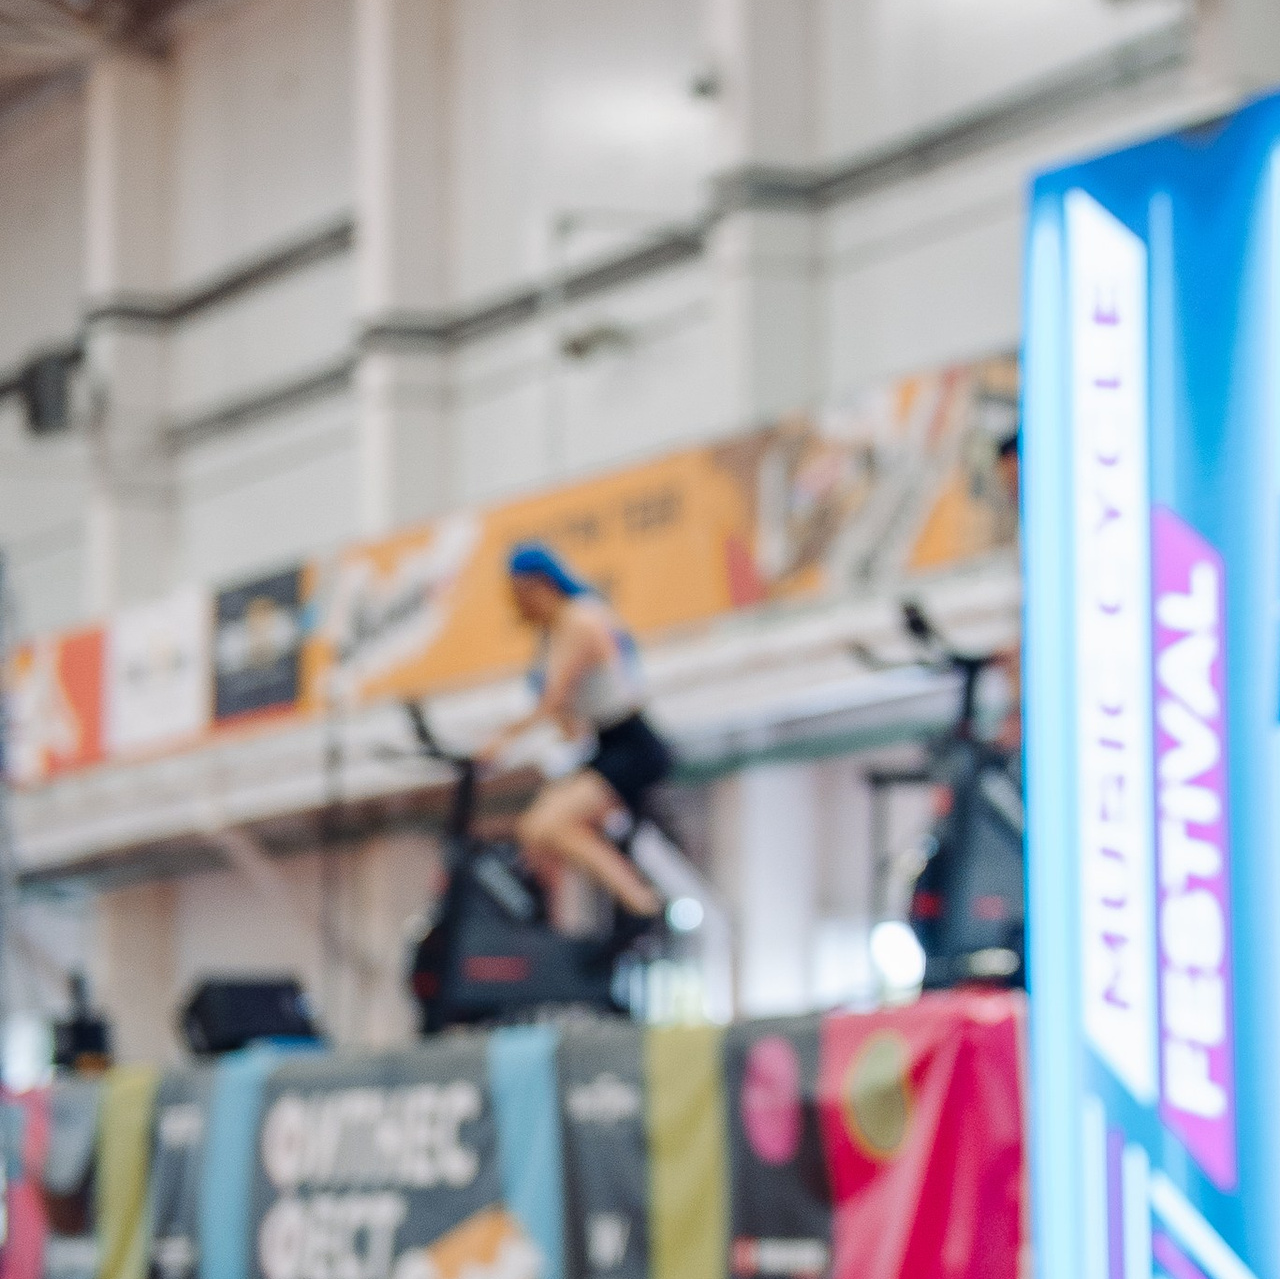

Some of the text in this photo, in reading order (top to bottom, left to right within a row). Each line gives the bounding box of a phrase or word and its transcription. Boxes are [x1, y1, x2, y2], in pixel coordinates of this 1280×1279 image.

[1090, 282, 1133, 1012] MUSIC CYCLE
[1157, 560, 1227, 1118] FESTIVAL
